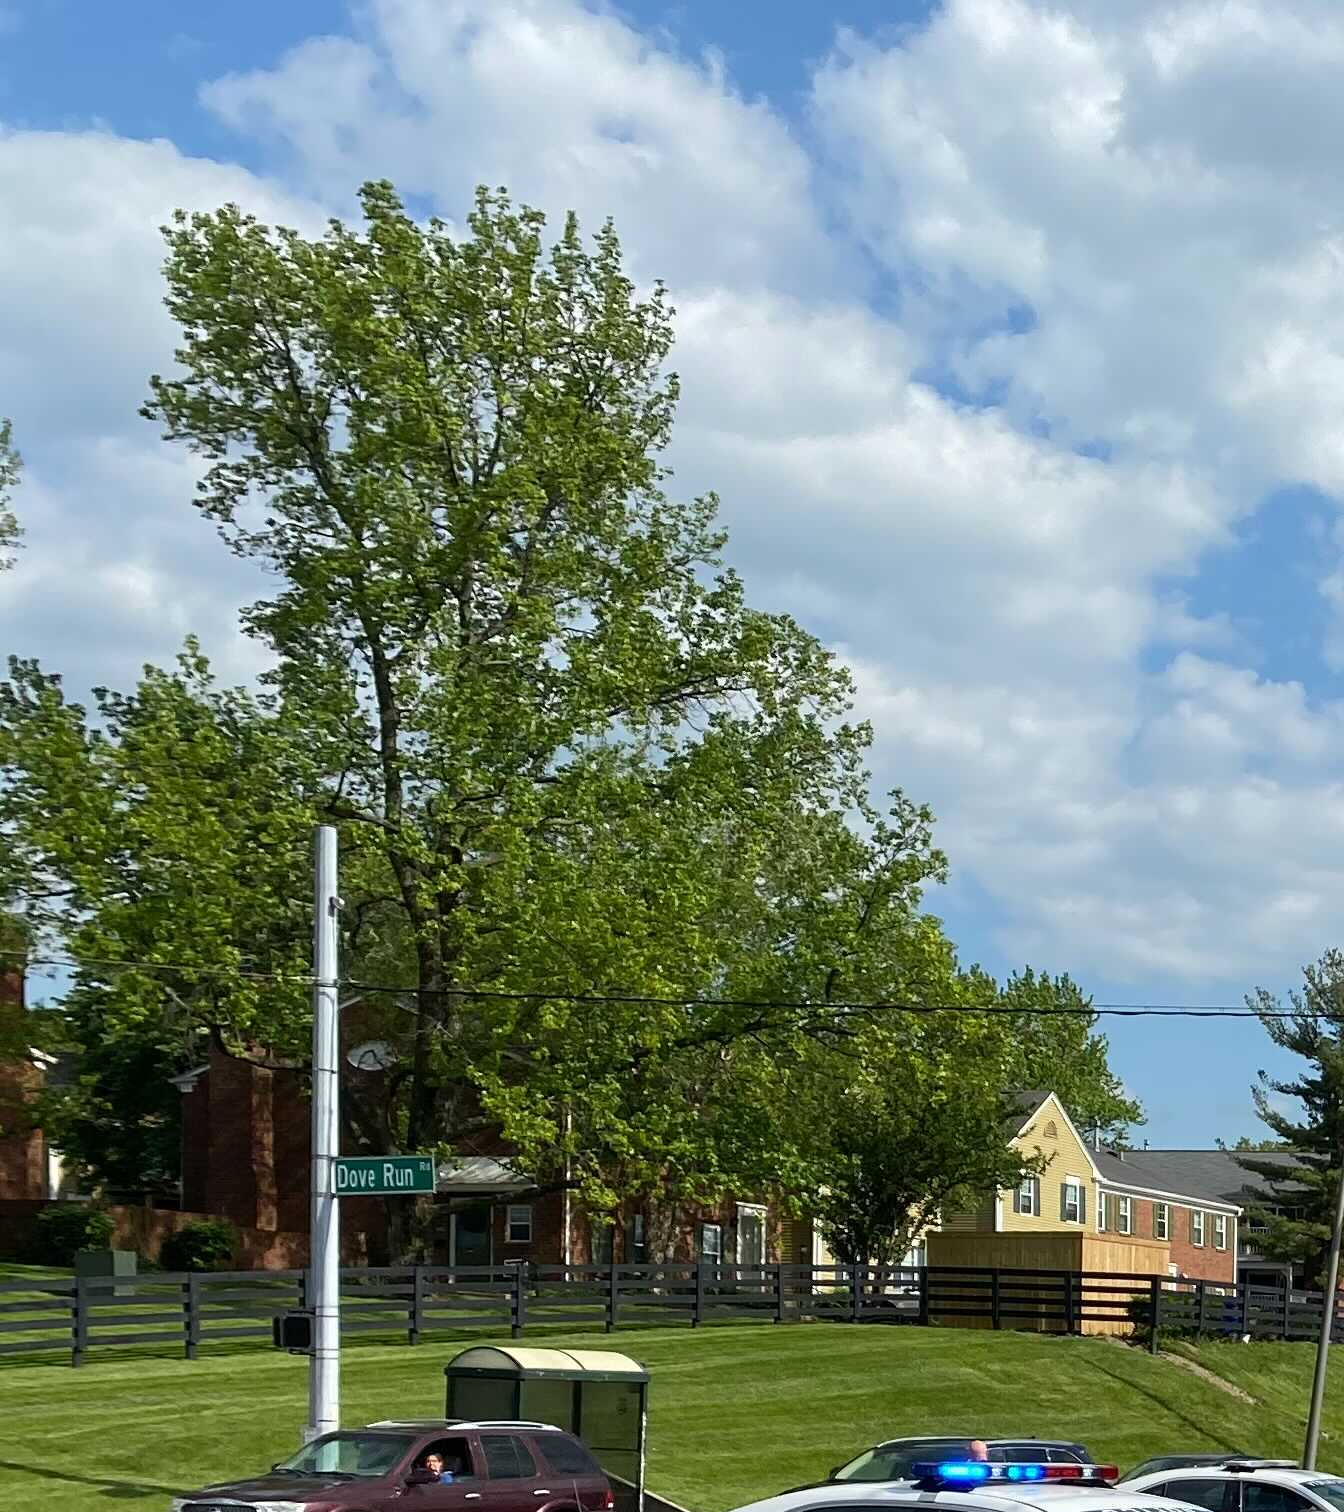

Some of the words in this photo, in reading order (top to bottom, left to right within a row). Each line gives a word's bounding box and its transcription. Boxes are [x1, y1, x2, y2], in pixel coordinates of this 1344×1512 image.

[337, 1164, 376, 1188] Dove
[383, 1163, 414, 1187] Run
[419, 1161, 431, 1171] Rd
